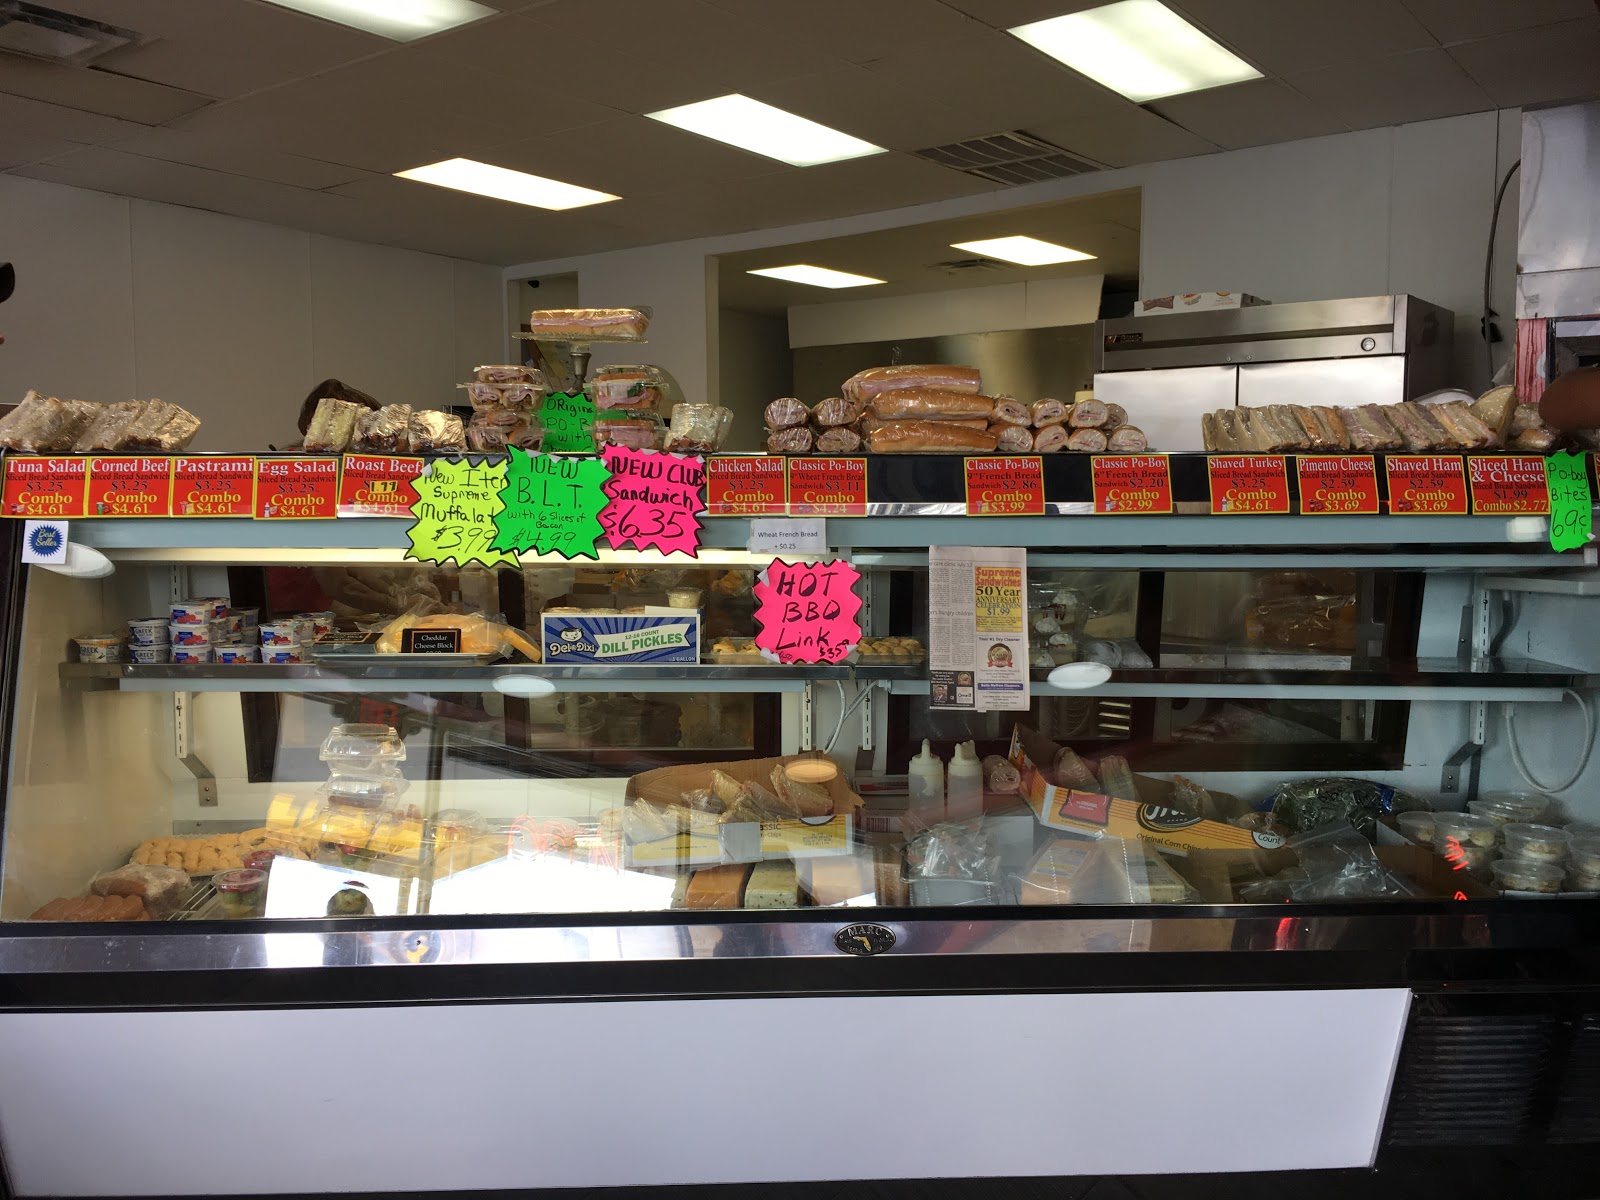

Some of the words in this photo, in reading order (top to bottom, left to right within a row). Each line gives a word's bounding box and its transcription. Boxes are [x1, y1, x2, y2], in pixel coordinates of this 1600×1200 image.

[558, 431, 593, 442] with
[8, 460, 43, 472] Tuna
[48, 459, 85, 472] Salad
[92, 458, 138, 472] Corned
[142, 458, 171, 472] Beef
[176, 458, 254, 472] Pastrami
[259, 462, 289, 476] Egg
[294, 461, 336, 473] Salad
[345, 456, 386, 472] Roast
[389, 458, 422, 474] Beef
[530, 458, 578, 480] NEW
[709, 459, 752, 472] Chicken
[755, 459, 784, 472] Salad
[790, 460, 826, 471] Classic
[828, 460, 864, 474] Po-Boy
[966, 459, 1002, 470] Classic
[1004, 459, 1040, 472] Po-Boy
[1093, 458, 1128, 469] Classic
[1132, 458, 1167, 471] Po-Boy
[1210, 458, 1244, 469] Shaved
[1248, 458, 1284, 470] Turkey
[1300, 458, 1338, 472] Pimento
[1340, 458, 1373, 471] Cheese
[1388, 458, 1430, 471] Shaved
[1432, 458, 1462, 471] Ham
[1470, 458, 1508, 472] Sliced
[1512, 458, 1544, 471] Ham
[6, 473, 26, 481] Sliced
[136, 472, 170, 480] Sandwich
[174, 472, 195, 480] Sliced
[198, 472, 218, 480] Bread
[220, 472, 254, 480] Sandwich
[424, 467, 454, 484] New
[612, 456, 662, 479] NEW
[667, 464, 707, 487] CLUB
[752, 472, 784, 480] Sandwich
[979, 472, 1012, 480] French
[1014, 472, 1042, 480] Bread
[1141, 470, 1168, 478] Bread
[1253, 470, 1286, 478] Sandwich
[1472, 472, 1486, 482] &
[1490, 471, 1544, 482] Cheese
[26, 481, 63, 491] $3.25
[112, 480, 148, 491] $3.25
[195, 480, 232, 491] $3.25
[728, 480, 764, 490] $3.25
[790, 482, 824, 490] Sandwich
[825, 482, 860, 491] $3.11
[968, 482, 1000, 490] Sandwich
[1002, 480, 1037, 490] $2.86
[1094, 480, 1128, 488] Sandwich
[1130, 478, 1164, 489] $2.20
[1232, 478, 1266, 488] $3.25
[1322, 479, 1355, 489] $2.59
[1410, 479, 1444, 490] $2.59
[278, 484, 315, 494] $3.25
[1226, 489, 1277, 500] Combo
[1316, 489, 1366, 500] Combo
[1404, 489, 1455, 500] Combo
[1551, 485, 1588, 503] Bites
[18, 492, 72, 504] Combo
[103, 491, 158, 503] Combo
[187, 491, 241, 503] Combo
[271, 494, 324, 506] Combo
[355, 489, 408, 504] Combo
[434, 486, 492, 505] Supreme
[606, 479, 694, 512] Sandwich
[723, 490, 774, 502] Combo
[804, 492, 855, 504] Combo
[982, 490, 1032, 502] Combo
[1108, 489, 1160, 501] Combo
[1494, 490, 1528, 500] $1.99
[27, 504, 64, 514] $4.61
[112, 504, 148, 514] $4.61
[196, 502, 233, 514] $4.61
[280, 506, 316, 516] $4.61
[364, 502, 398, 514] $4.61
[732, 502, 766, 512] $4.61
[812, 503, 847, 514] $4.24
[991, 502, 1025, 512] $3.99
[1118, 500, 1153, 511] $2.99
[1236, 500, 1269, 511] $4.61
[1325, 500, 1360, 511] $3.69
[1414, 500, 1448, 512] $3.69
[1474, 500, 1512, 511] Combo
[1514, 500, 1545, 512] $2.77
[508, 509, 535, 520] with
[538, 510, 547, 522] 6
[549, 512, 574, 522] Slices
[536, 520, 564, 530] Bacon
[38, 528, 56, 538] Best
[35, 538, 58, 546] Seller
[431, 525, 498, 554] $3.99
[508, 528, 576, 552] $4.99
[976, 566, 1020, 578] Supreme
[776, 571, 839, 597] HOT
[976, 576, 1021, 586] Sandwiches
[976, 586, 994, 596] 50
[995, 586, 1021, 596] Year
[976, 596, 1020, 604] ANNIVERSARY
[782, 600, 840, 624] BBQ
[987, 608, 1010, 616] $1.99
[420, 634, 448, 642] Cheddar
[641, 629, 660, 637] COUNT
[776, 626, 830, 650] Link
[602, 640, 628, 654] DILL
[632, 632, 683, 650] PICKLES
[1136, 832, 1164, 846] Original
[1164, 839, 1181, 848] Corn
[1258, 833, 1281, 845] Count
[848, 926, 882, 936] MARC
